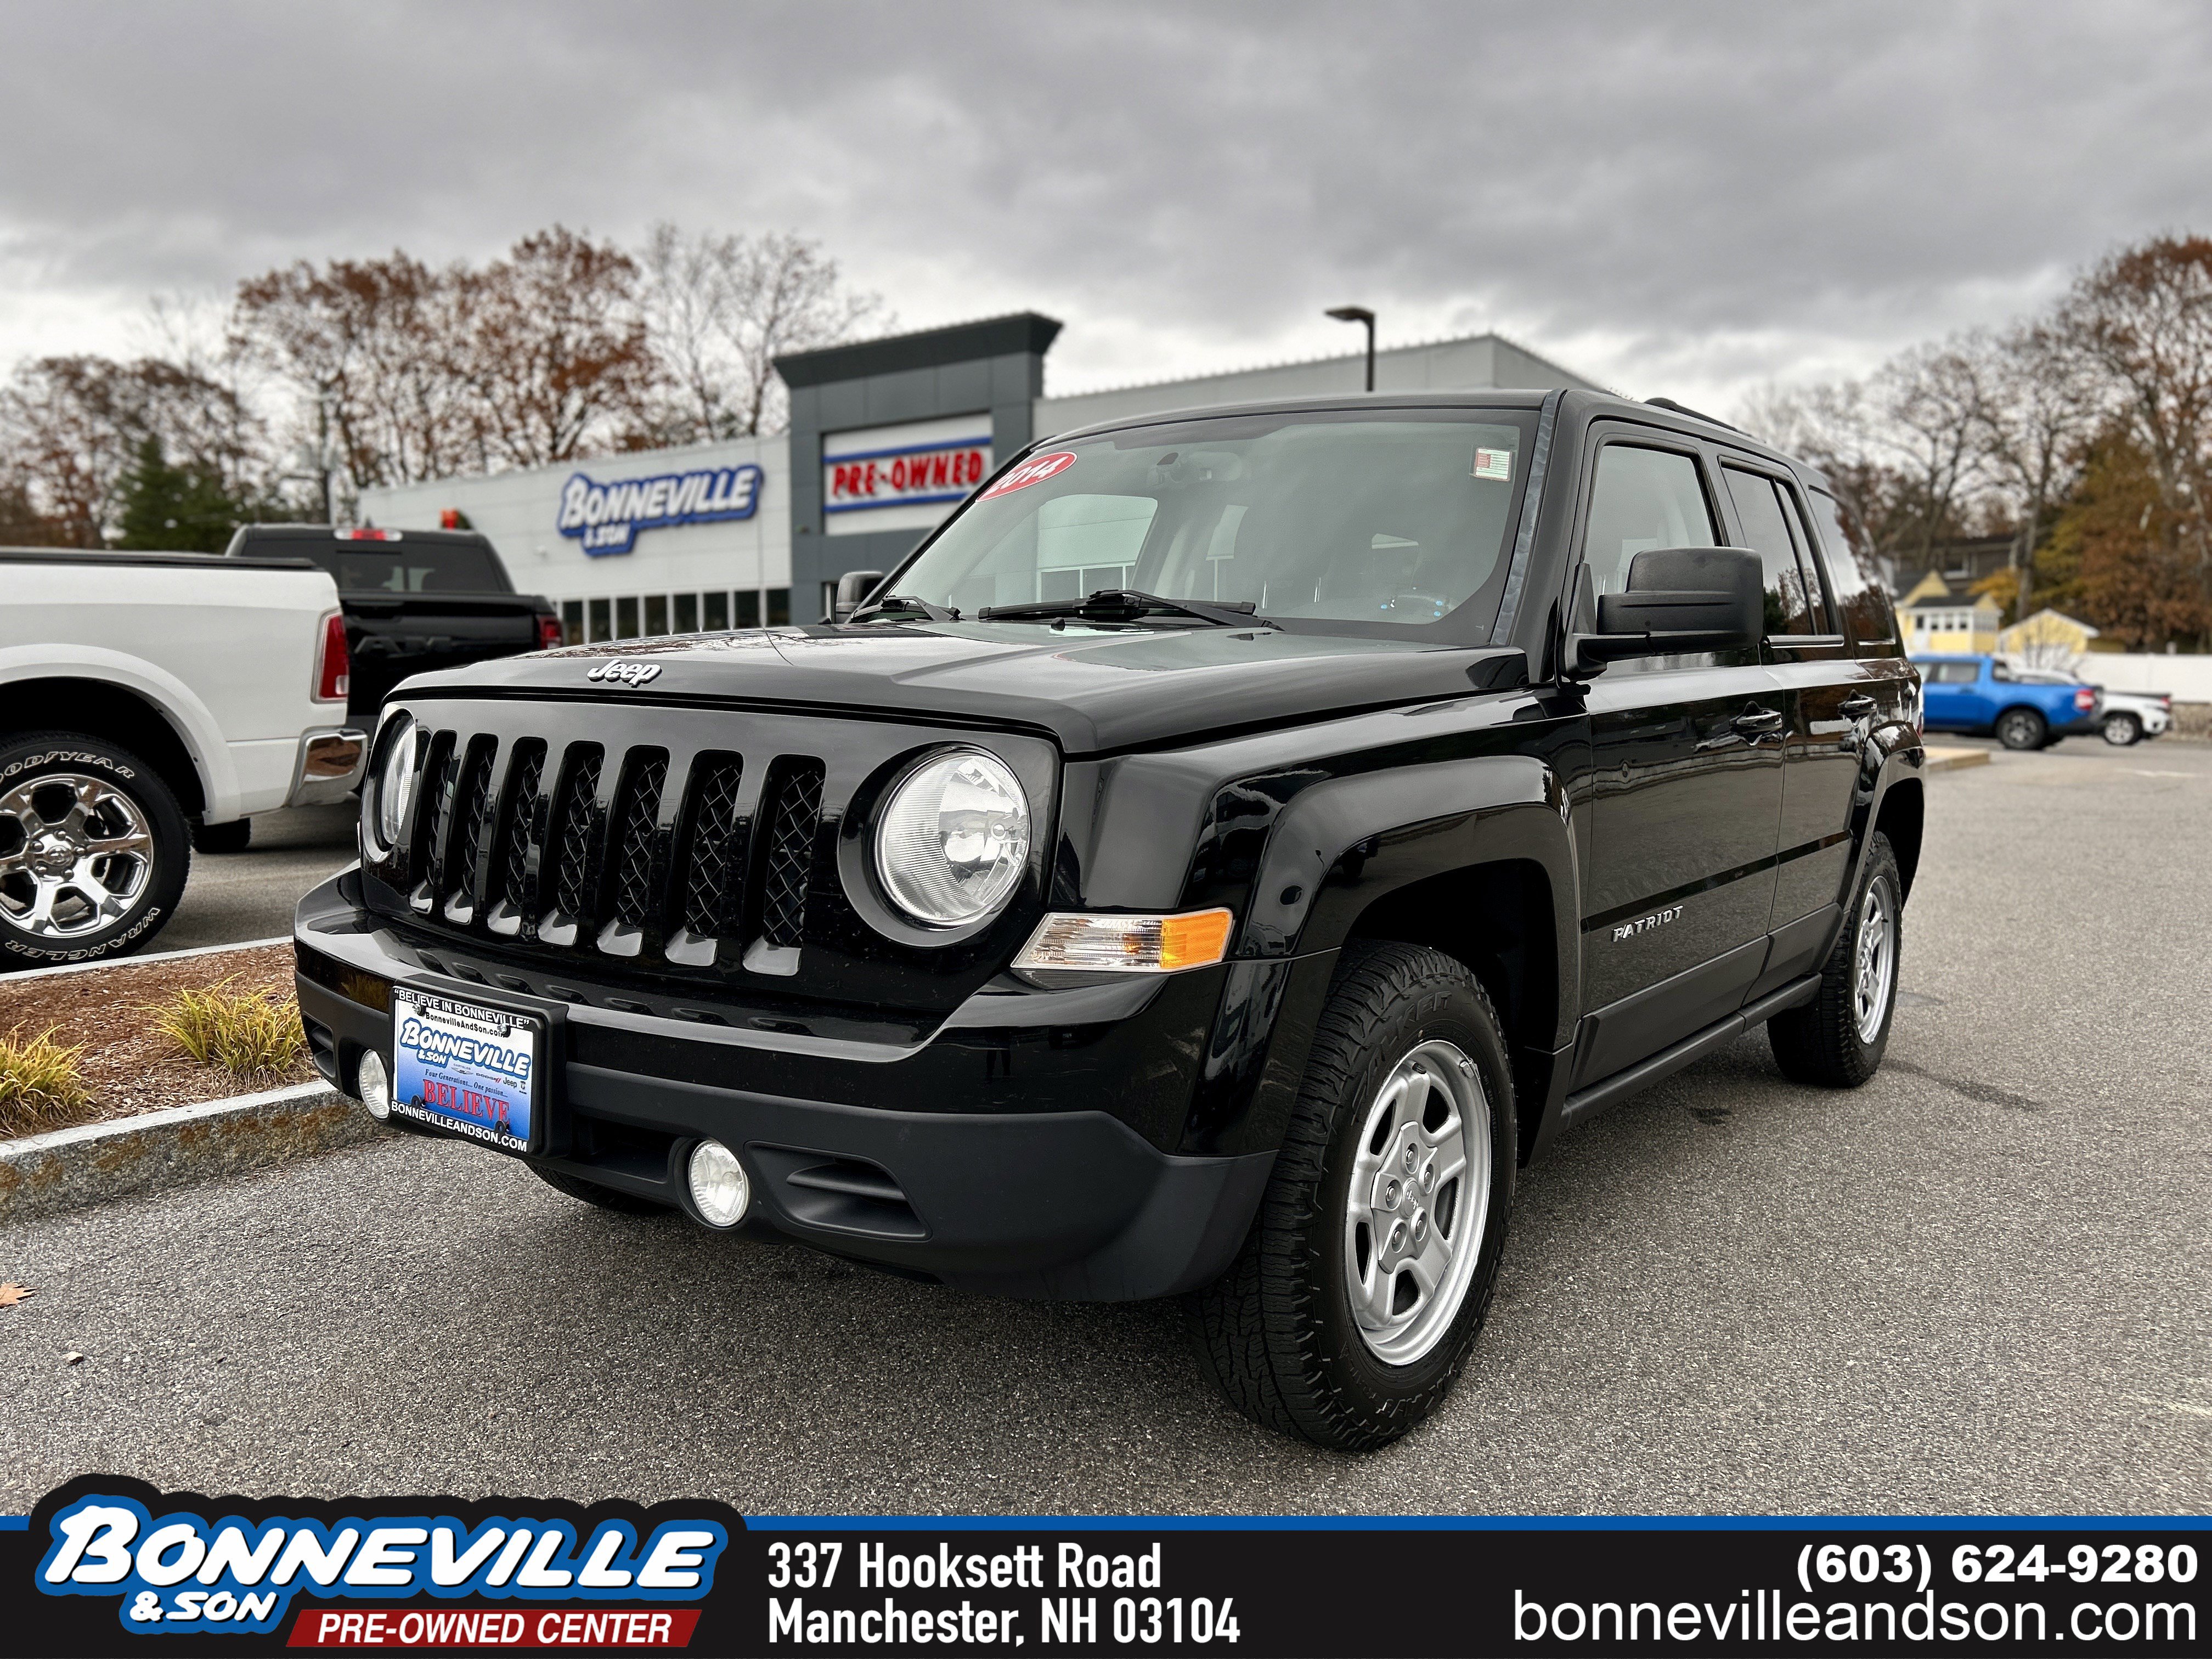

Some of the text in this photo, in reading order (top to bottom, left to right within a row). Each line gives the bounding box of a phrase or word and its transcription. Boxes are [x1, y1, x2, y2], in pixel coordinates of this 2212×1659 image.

[832, 448, 984, 497] PRE-OWNED
[560, 467, 757, 529] BONNEVILLE
[586, 659, 662, 686] Jeep
[0, 751, 135, 785] ODYEAR
[4, 907, 161, 961] WRANGLER
[1611, 905, 1684, 943] PATRIOT
[442, 1001, 453, 1013] IN
[402, 1019, 529, 1076] BONNEVILLE
[425, 1069, 438, 1078] Four
[473, 1081, 484, 1091] One
[503, 1077, 517, 1089] Jeep
[423, 1079, 510, 1124] BELIEVE
[391, 1101, 527, 1152] BONNEVILLEANDSON.COM
